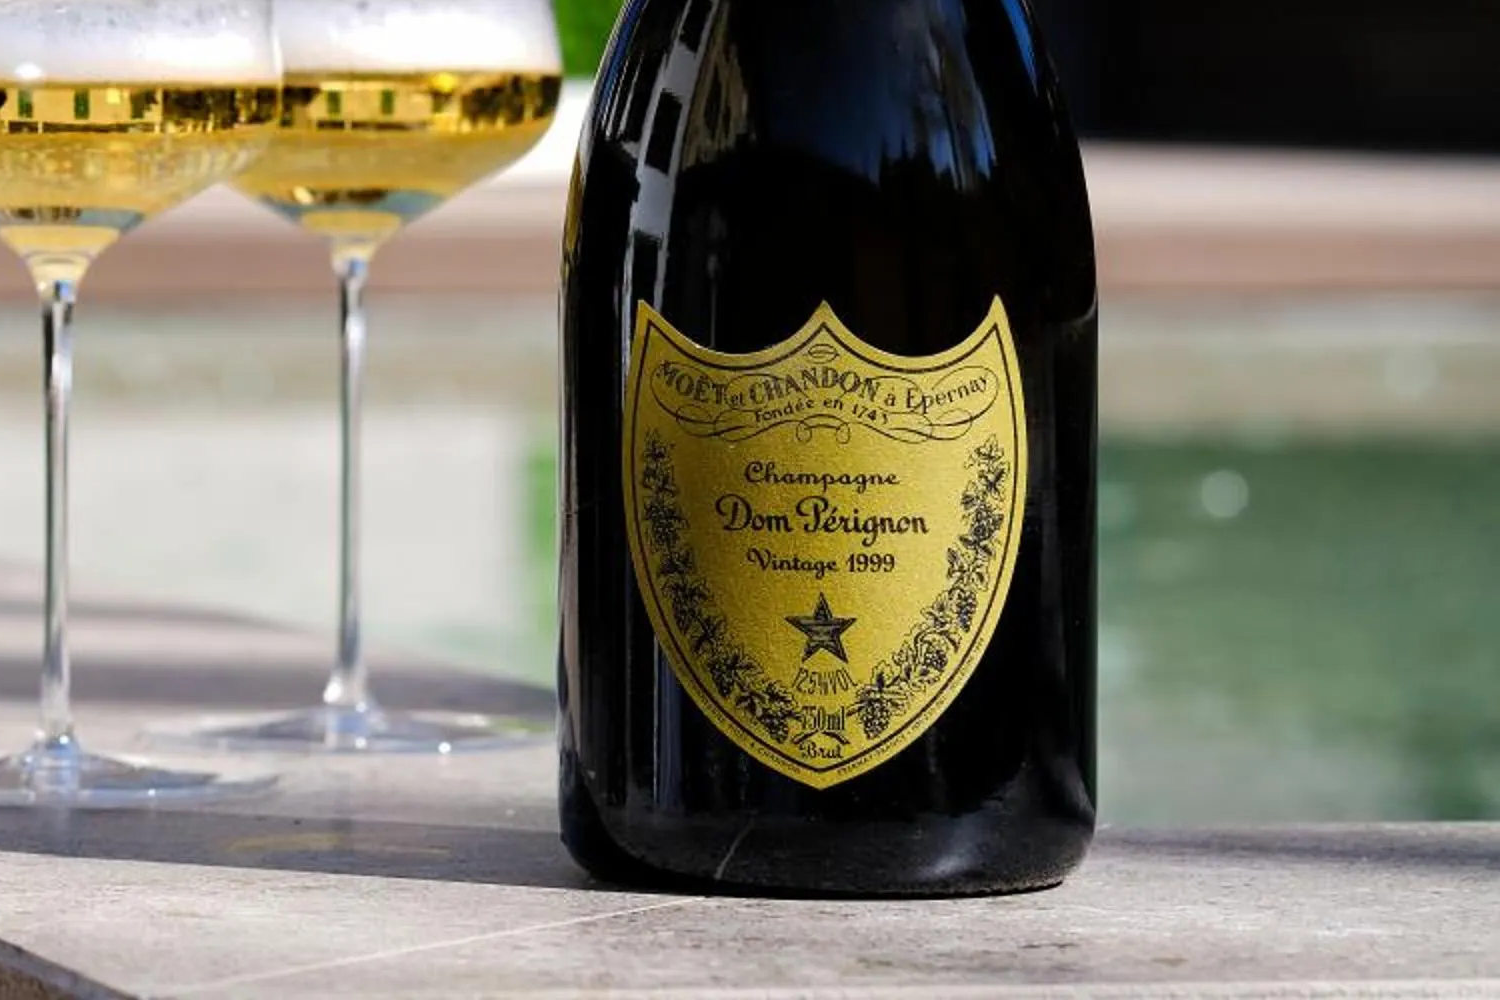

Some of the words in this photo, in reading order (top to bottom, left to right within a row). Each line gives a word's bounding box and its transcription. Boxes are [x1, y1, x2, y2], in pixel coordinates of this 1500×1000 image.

[749, 366, 881, 405] CHANDON
[823, 398, 843, 411] en
[743, 460, 901, 494] Champagne
[714, 493, 794, 532] Dom
[795, 495, 930, 548] Pérignon
[747, 548, 838, 581] Vintage
[846, 552, 896, 574] 1999
[799, 741, 844, 759] Brut
